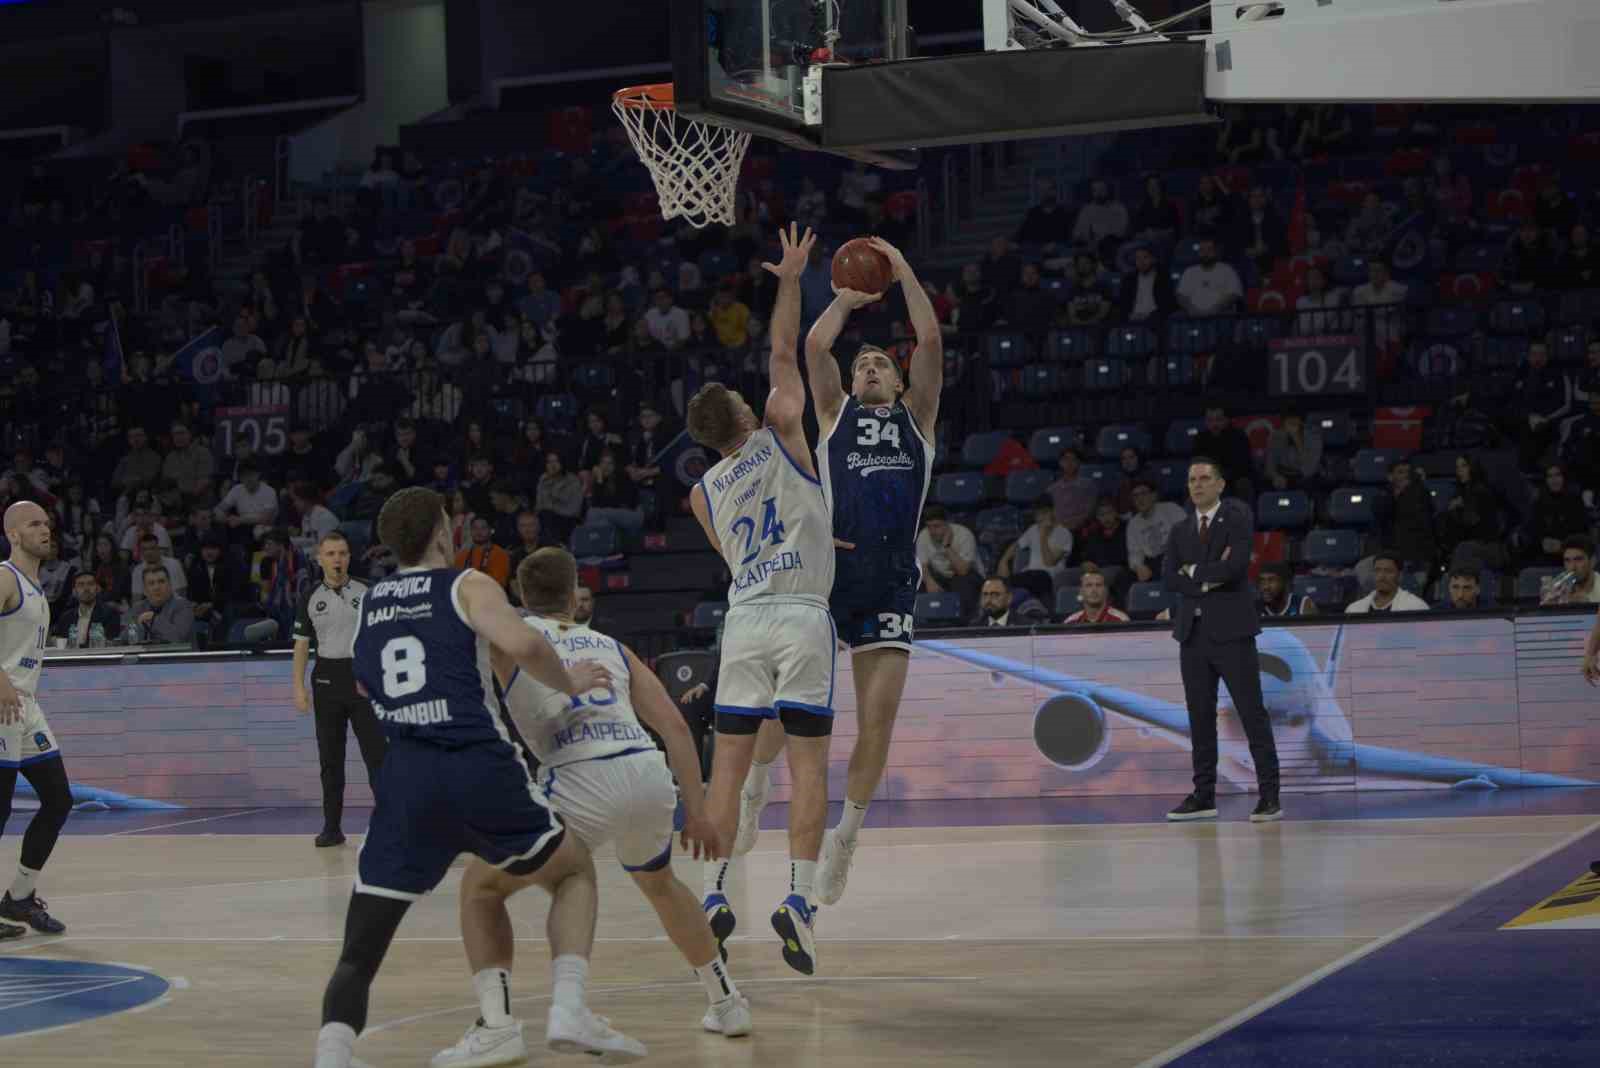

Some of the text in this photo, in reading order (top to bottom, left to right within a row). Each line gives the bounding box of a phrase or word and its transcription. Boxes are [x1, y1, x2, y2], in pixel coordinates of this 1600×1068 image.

[1272, 349, 1361, 392] 104
[219, 416, 287, 456] 105
[856, 418, 901, 449] 34
[731, 497, 785, 565] 24
[380, 634, 427, 699] 8
